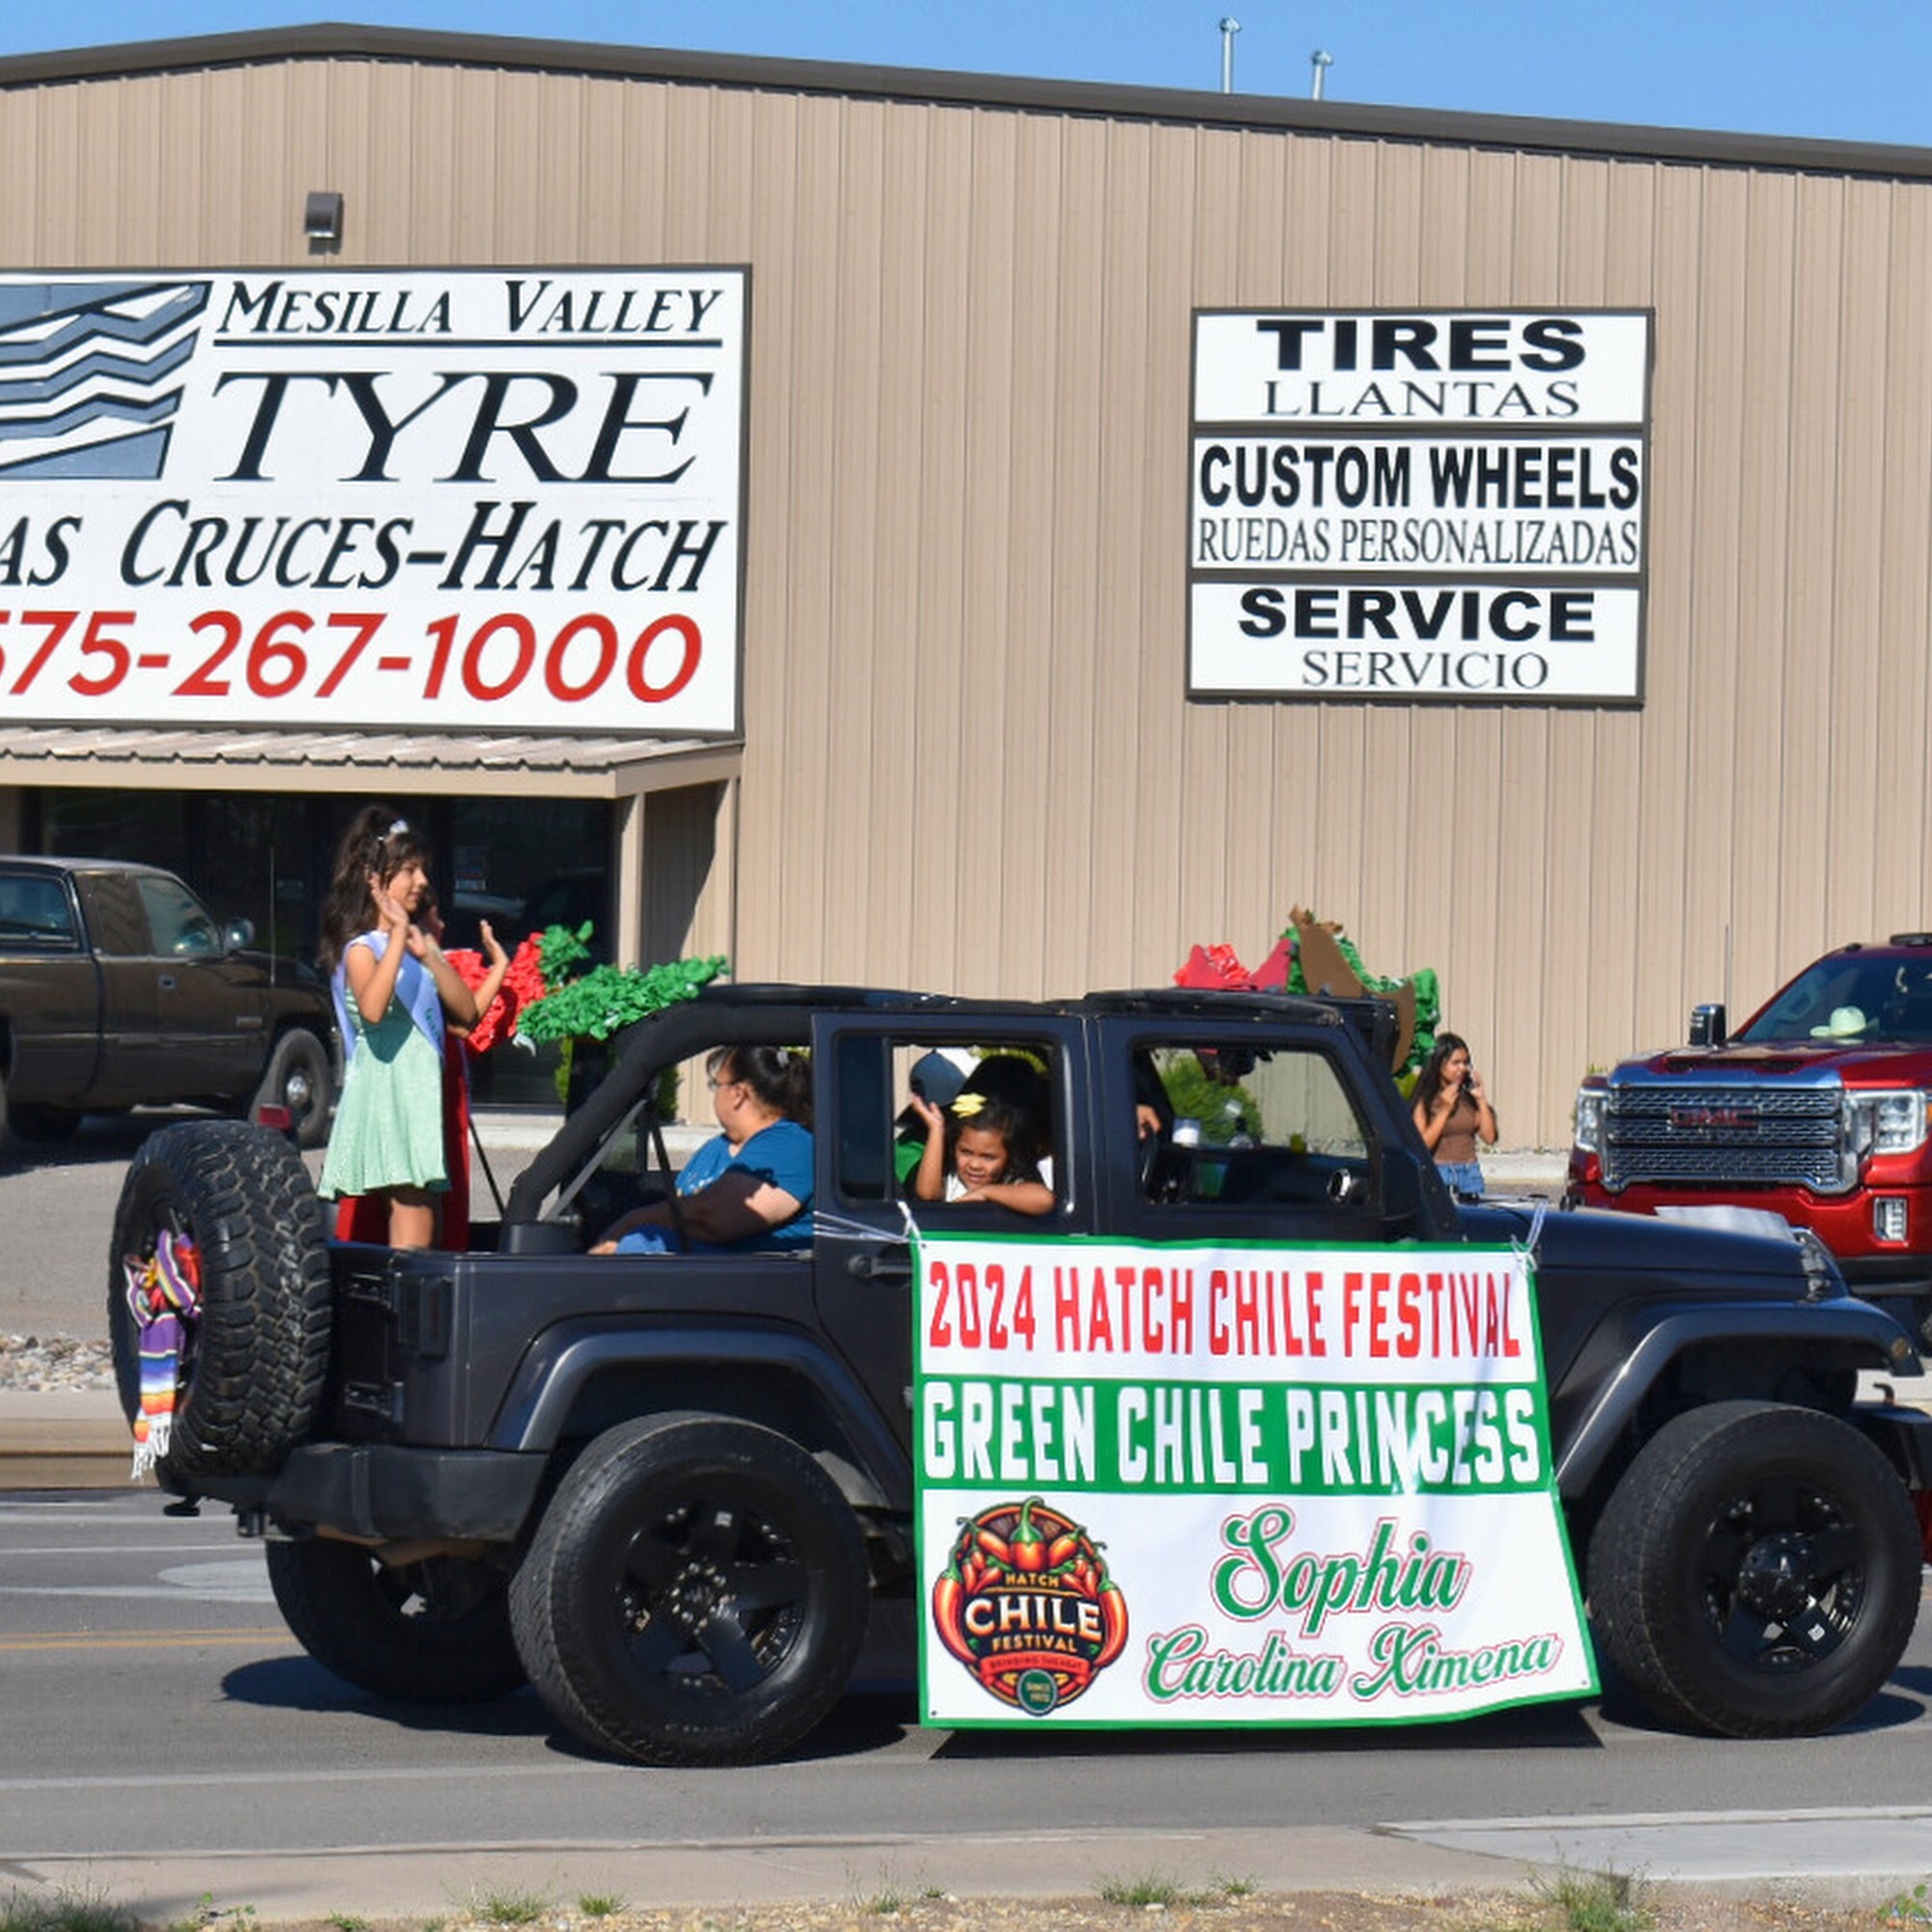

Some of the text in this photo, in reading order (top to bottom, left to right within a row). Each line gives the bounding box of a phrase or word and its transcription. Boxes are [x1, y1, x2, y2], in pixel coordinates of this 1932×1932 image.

[216, 280, 723, 333] MESILLA VALLEY
[1256, 319, 1586, 373] TIRES
[1263, 381, 1580, 417] LLANTAS
[213, 371, 714, 484] TYRE
[1200, 444, 1639, 511] CUSTOM WHEELS
[120, 498, 728, 592] CRUCES-HATCH
[1198, 518, 1637, 565] RUEDAS PERSONALIZADAS
[1237, 587, 1596, 642] SERVICE
[0, 610, 703, 703] 75-267-1000
[1301, 650, 1549, 690] SERVICIO
[929, 1261, 1520, 1358] 2024 HATCH CHILE FESTIVAL
[923, 1381, 1542, 1485] GREEN CHILE PRINCESS
[1005, 1572, 1060, 1589] HATCH
[1211, 1503, 1472, 1638] Sophia
[964, 1595, 1103, 1642] CHILE
[991, 1634, 1078, 1655] FESTIVAL
[1143, 1622, 1563, 1703] Carolina Ximena
